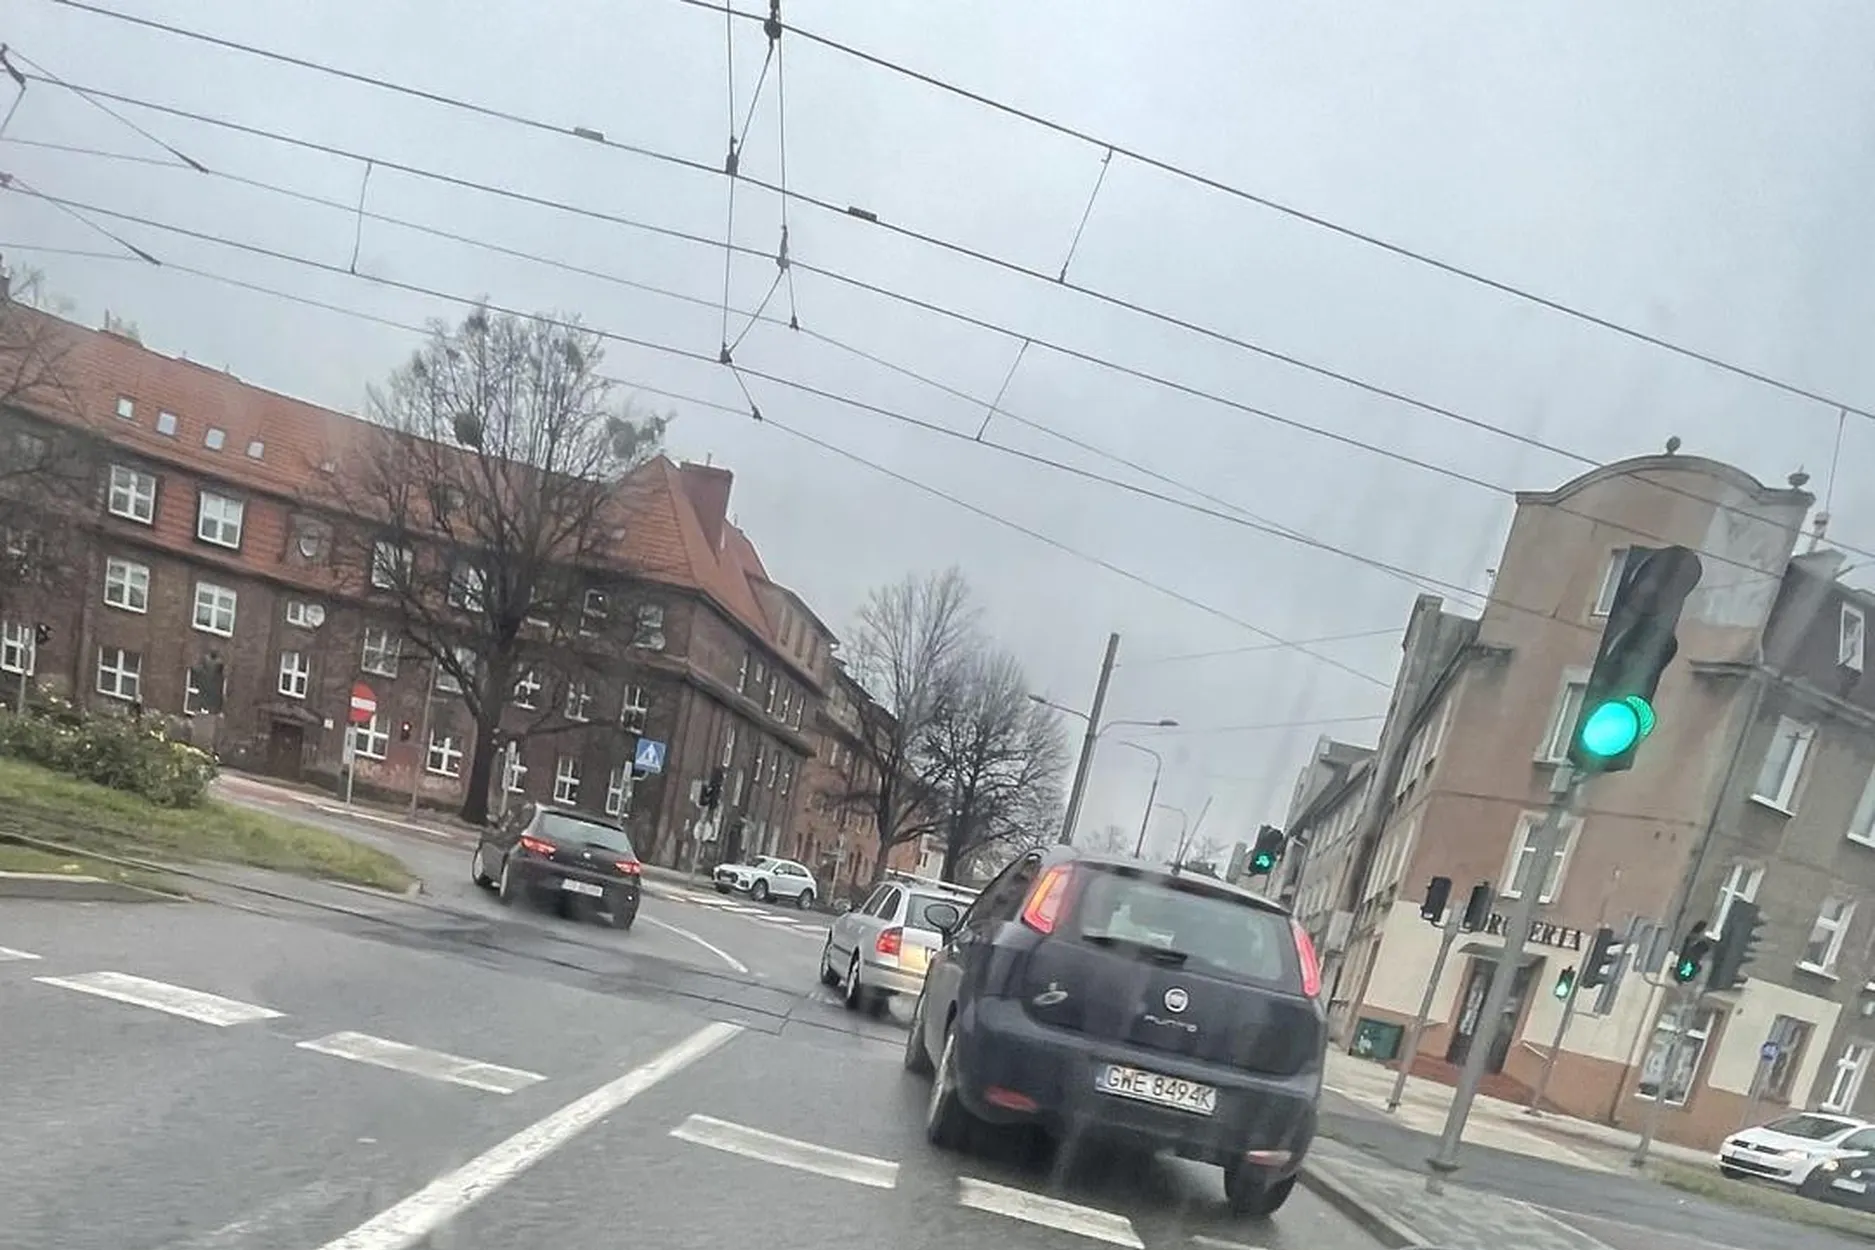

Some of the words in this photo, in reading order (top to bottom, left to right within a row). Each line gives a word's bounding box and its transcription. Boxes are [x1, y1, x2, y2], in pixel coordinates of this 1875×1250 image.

[1485, 911, 1582, 951] RERIA
[1107, 1066, 1147, 1093] GWE
[1152, 1076, 1213, 1109] 8494K
